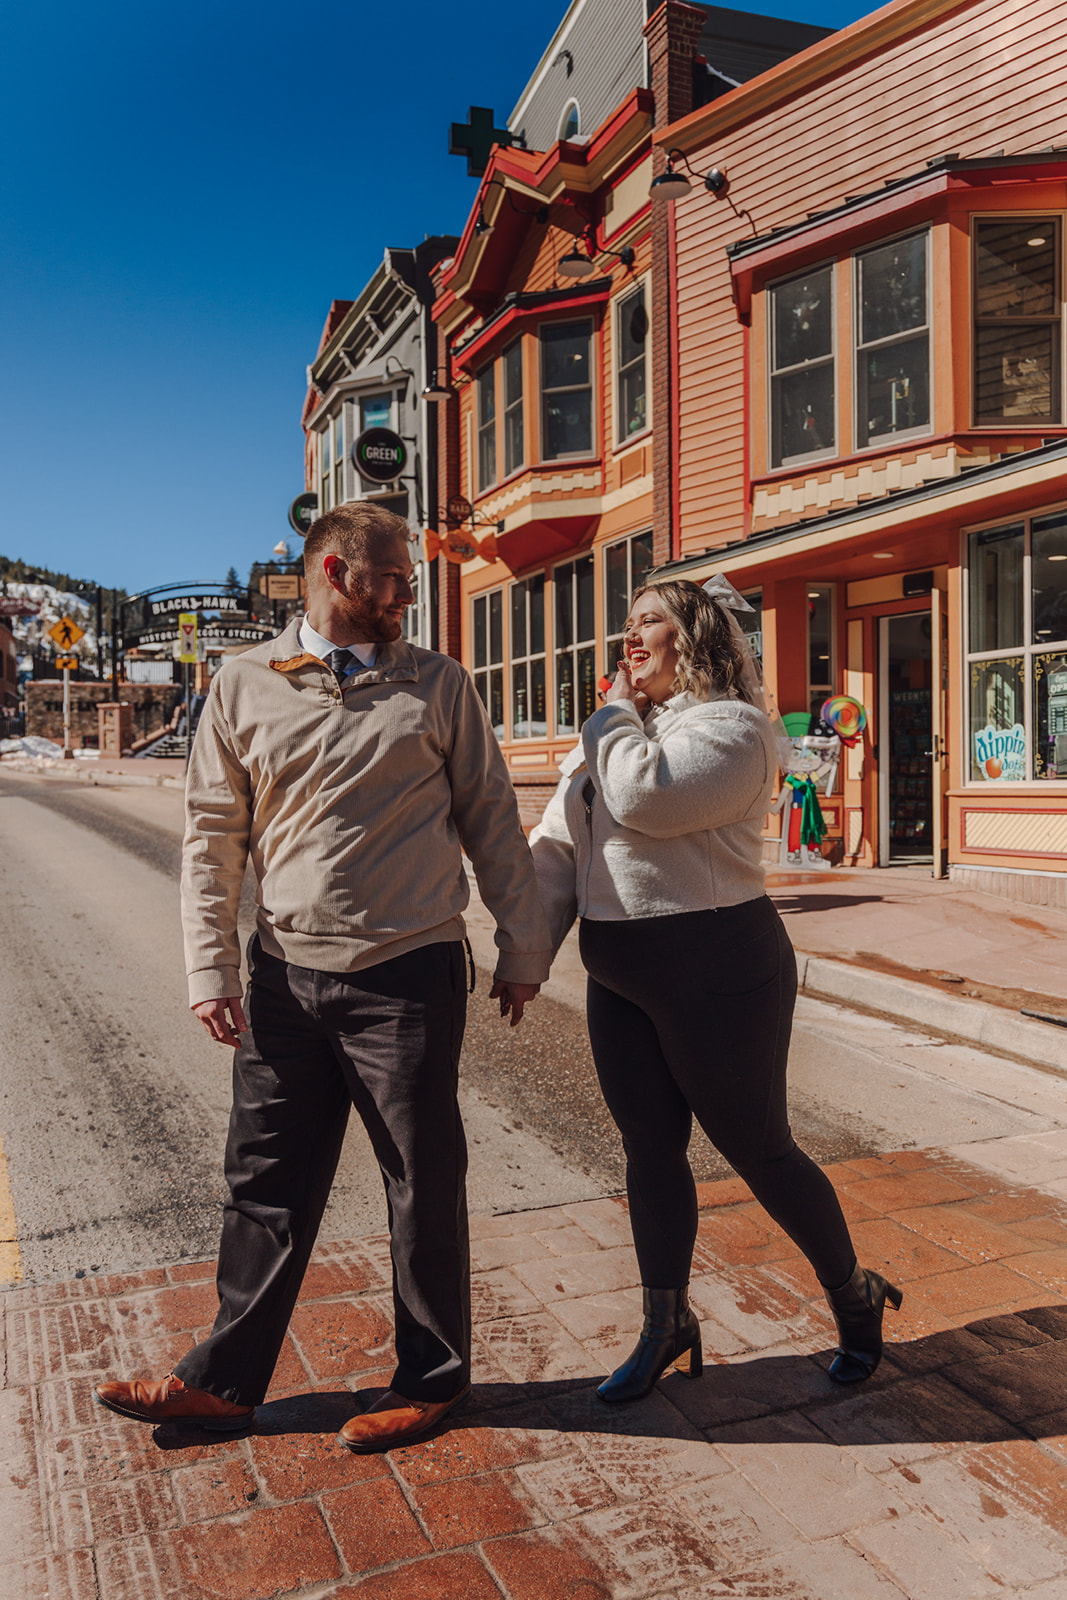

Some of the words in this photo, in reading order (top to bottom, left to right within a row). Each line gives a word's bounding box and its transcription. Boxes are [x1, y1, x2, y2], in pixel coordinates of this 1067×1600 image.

[366, 446, 398, 461] GREEN
[152, 597, 190, 615] BLACK
[202, 595, 238, 610] HAWK
[228, 628, 264, 640] STREET
